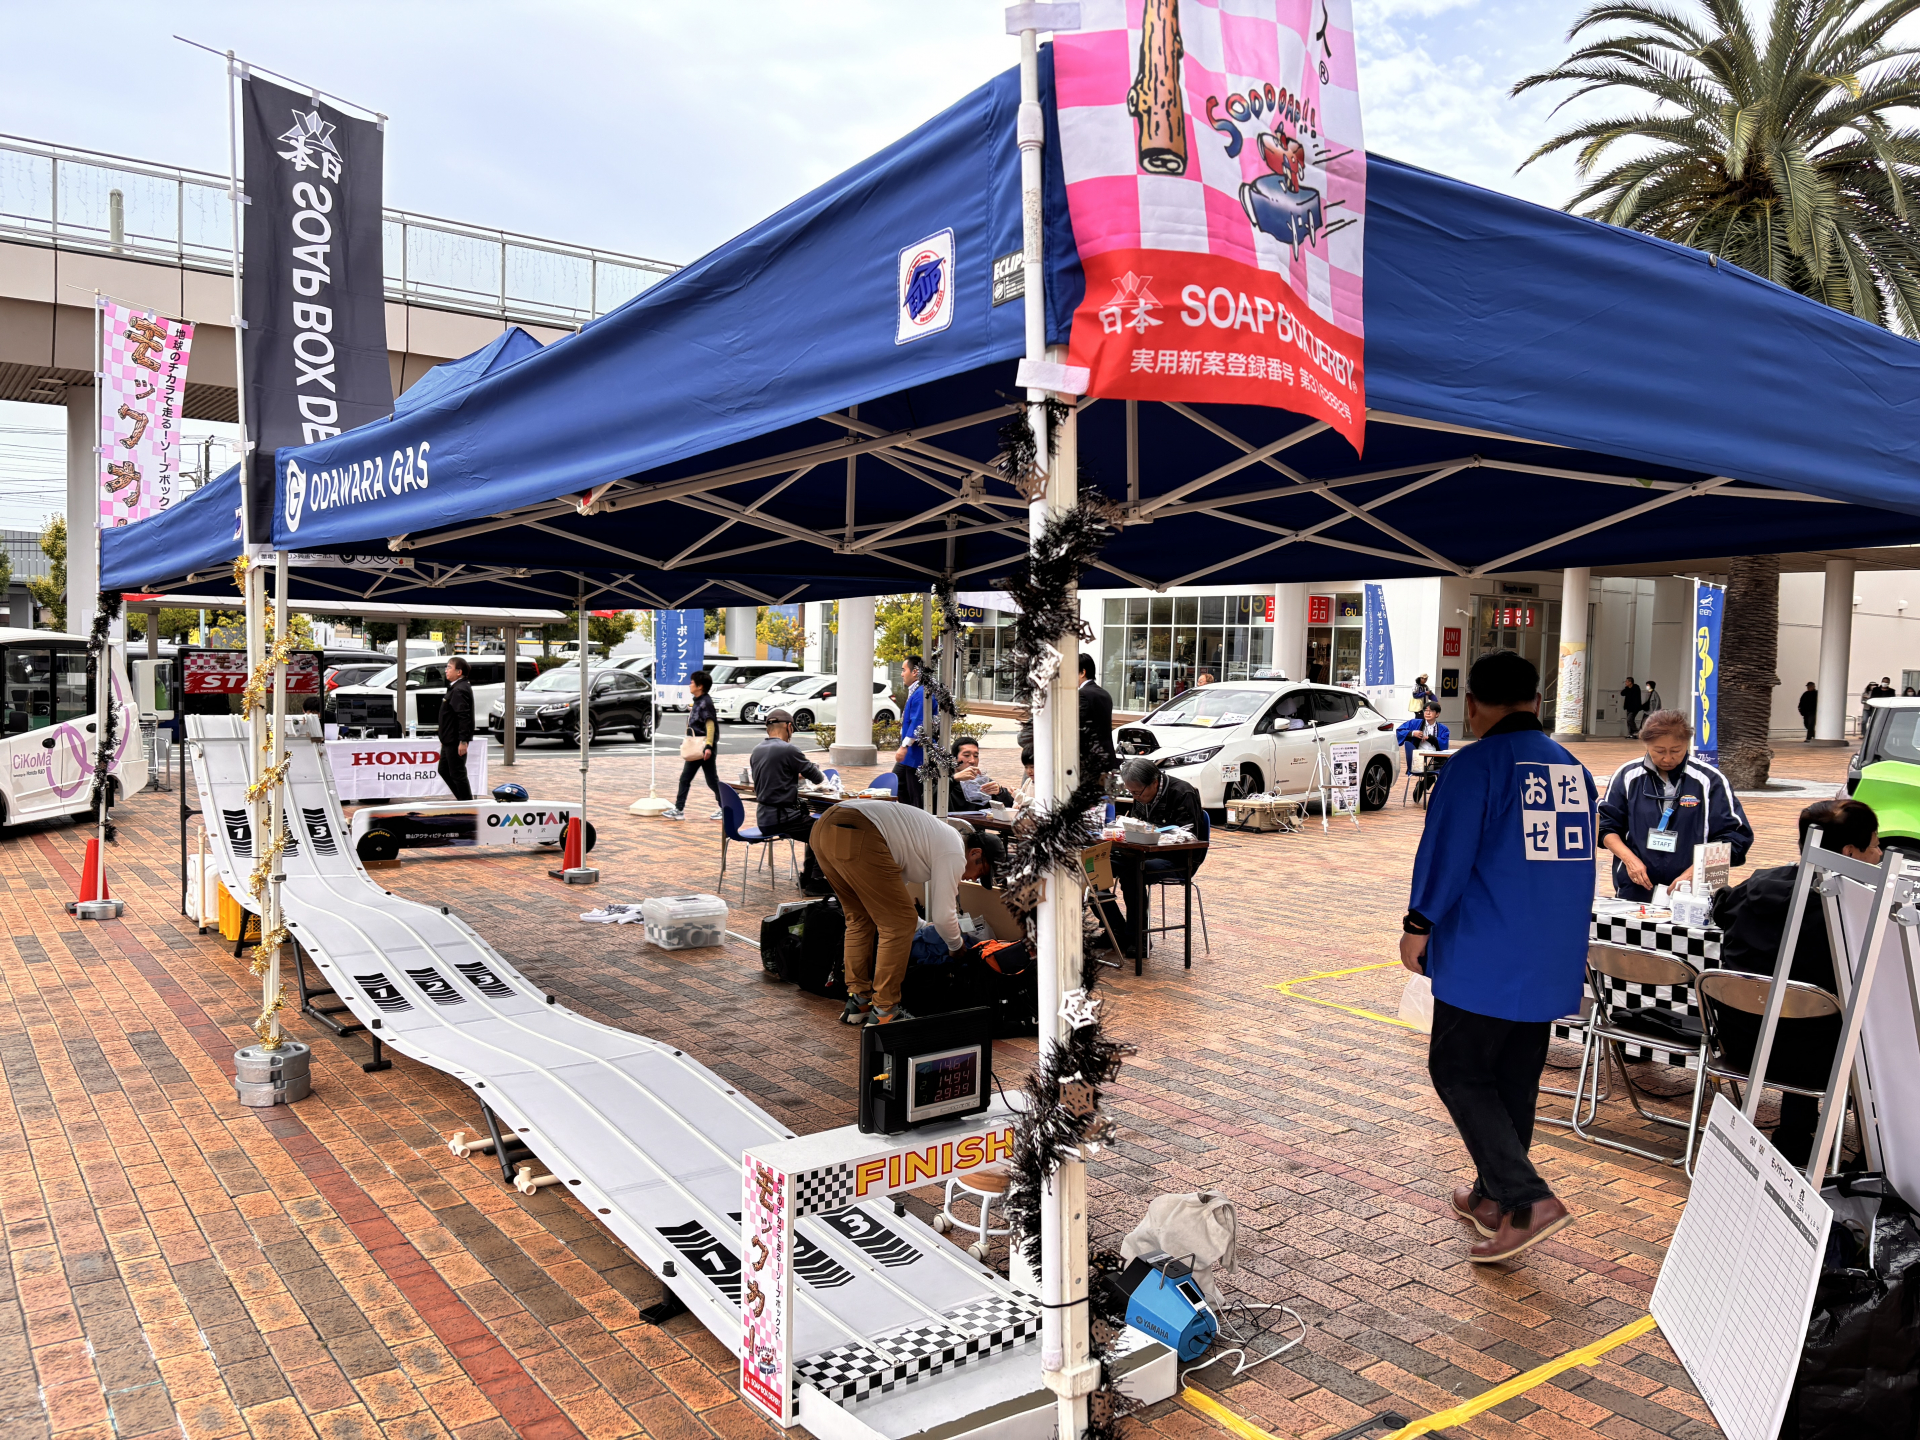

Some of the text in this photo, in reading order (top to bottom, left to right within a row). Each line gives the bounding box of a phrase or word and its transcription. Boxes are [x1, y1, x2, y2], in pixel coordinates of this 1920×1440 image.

[1180, 284, 1275, 334] SOAP
[1098, 298, 1164, 335] 日本
[1129, 348, 1295, 386] 実用新案登録番号
[158, 327, 187, 511] 地球のチカラで走る！ソープボック
[310, 441, 431, 512] ODAWARA GAS
[1313, 599, 1326, 608] ユニ
[968, 607, 983, 618] GU
[1312, 610, 1326, 620] クロ
[1345, 607, 1357, 617] GU
[1445, 631, 1459, 641] UNI
[1445, 642, 1459, 653] QLO
[1442, 676, 1459, 689] GU
[13, 751, 52, 770] CiKoMa
[351, 750, 441, 766] HOND
[377, 769, 438, 781] Honda R&D
[1524, 771, 1581, 805] おだ
[486, 810, 570, 828] OMOTAN
[233, 827, 245, 839] 1
[313, 826, 327, 838] 3
[1525, 820, 1584, 852] ゼロ
[1652, 839, 1673, 848] STAFF
[425, 980, 445, 992] 2
[475, 975, 494, 985] 3
[374, 987, 388, 998] 1
[855, 1127, 1015, 1198] FINISH
[839, 1213, 872, 1237] 3
[701, 1250, 727, 1272] 1
[1143, 1318, 1169, 1340] YAMAHA
